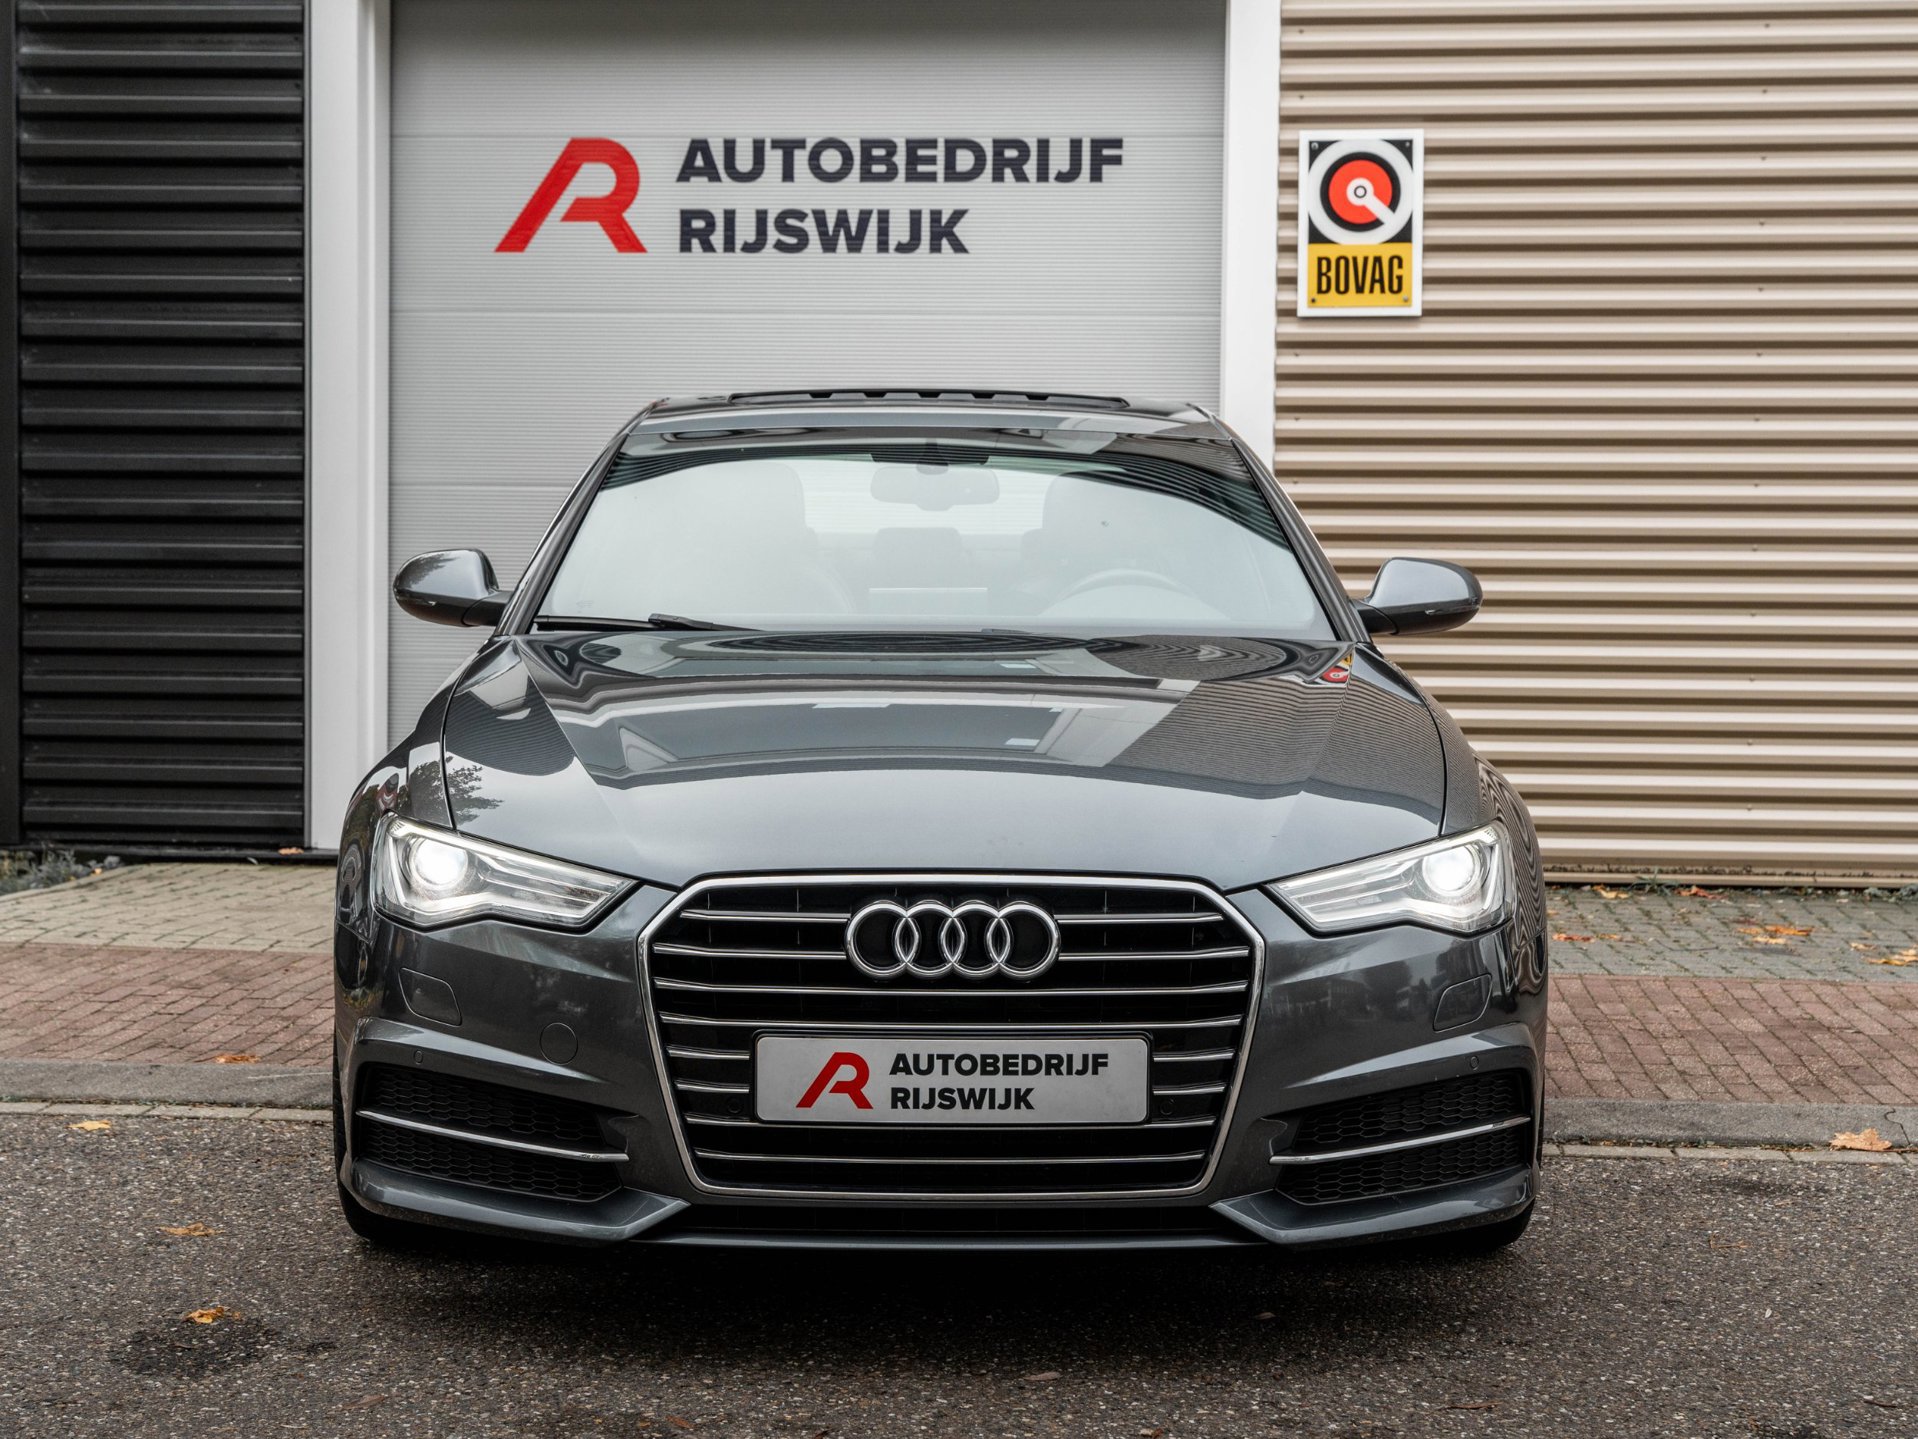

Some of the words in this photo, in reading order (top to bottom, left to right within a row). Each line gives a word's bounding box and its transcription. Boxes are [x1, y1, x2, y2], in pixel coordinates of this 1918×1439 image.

[676, 137, 1124, 184] AUTOBEDRIJF
[678, 208, 970, 254] RIJSWIJK
[1316, 255, 1404, 295] BOVAG
[889, 1053, 1109, 1077] AUTOBEDRIJF
[890, 1087, 1035, 1111] RIJSWIJK
